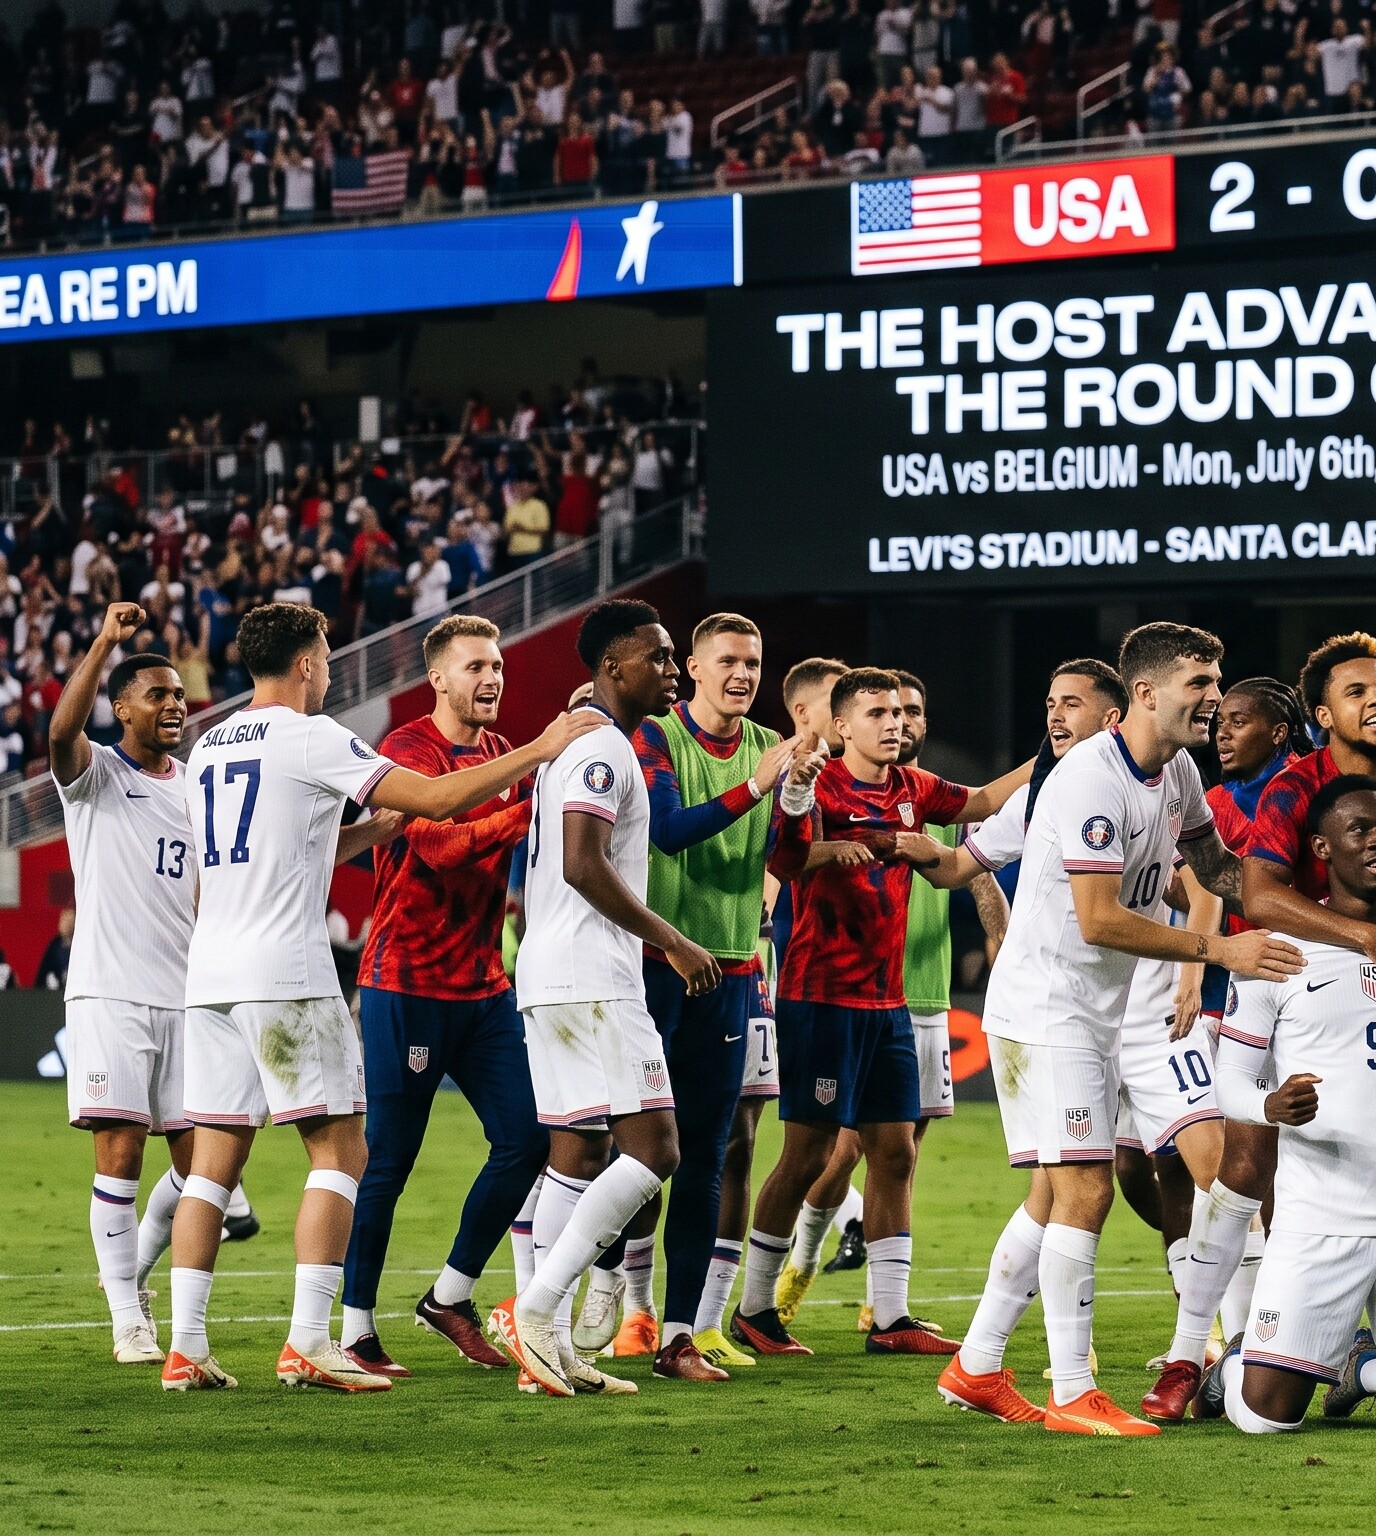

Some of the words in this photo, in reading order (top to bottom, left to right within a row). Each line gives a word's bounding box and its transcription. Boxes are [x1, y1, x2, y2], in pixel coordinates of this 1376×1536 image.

[1013, 174, 1150, 247] USA
[1209, 161, 1255, 233] 2
[59, 267, 119, 324] RE
[126, 259, 198, 318] PM
[776, 308, 924, 373] THE
[940, 294, 1155, 365] HOST
[895, 369, 1048, 435] THE
[1063, 354, 1355, 429] ROUND
[882, 452, 949, 498] USA
[951, 459, 989, 494] vs
[993, 443, 1138, 493] BELGIUM
[1162, 441, 1242, 490] Mon,
[1245, 436, 1316, 492] July
[868, 534, 975, 573] LEVI'S
[978, 528, 1139, 569] STADIUM
[1165, 523, 1288, 563] SANTA
[198, 758, 262, 868] 17
[155, 837, 187, 879] 13
[1127, 861, 1162, 909] 10
[755, 1024, 770, 1062] 7
[1168, 1049, 1212, 1093] 10
